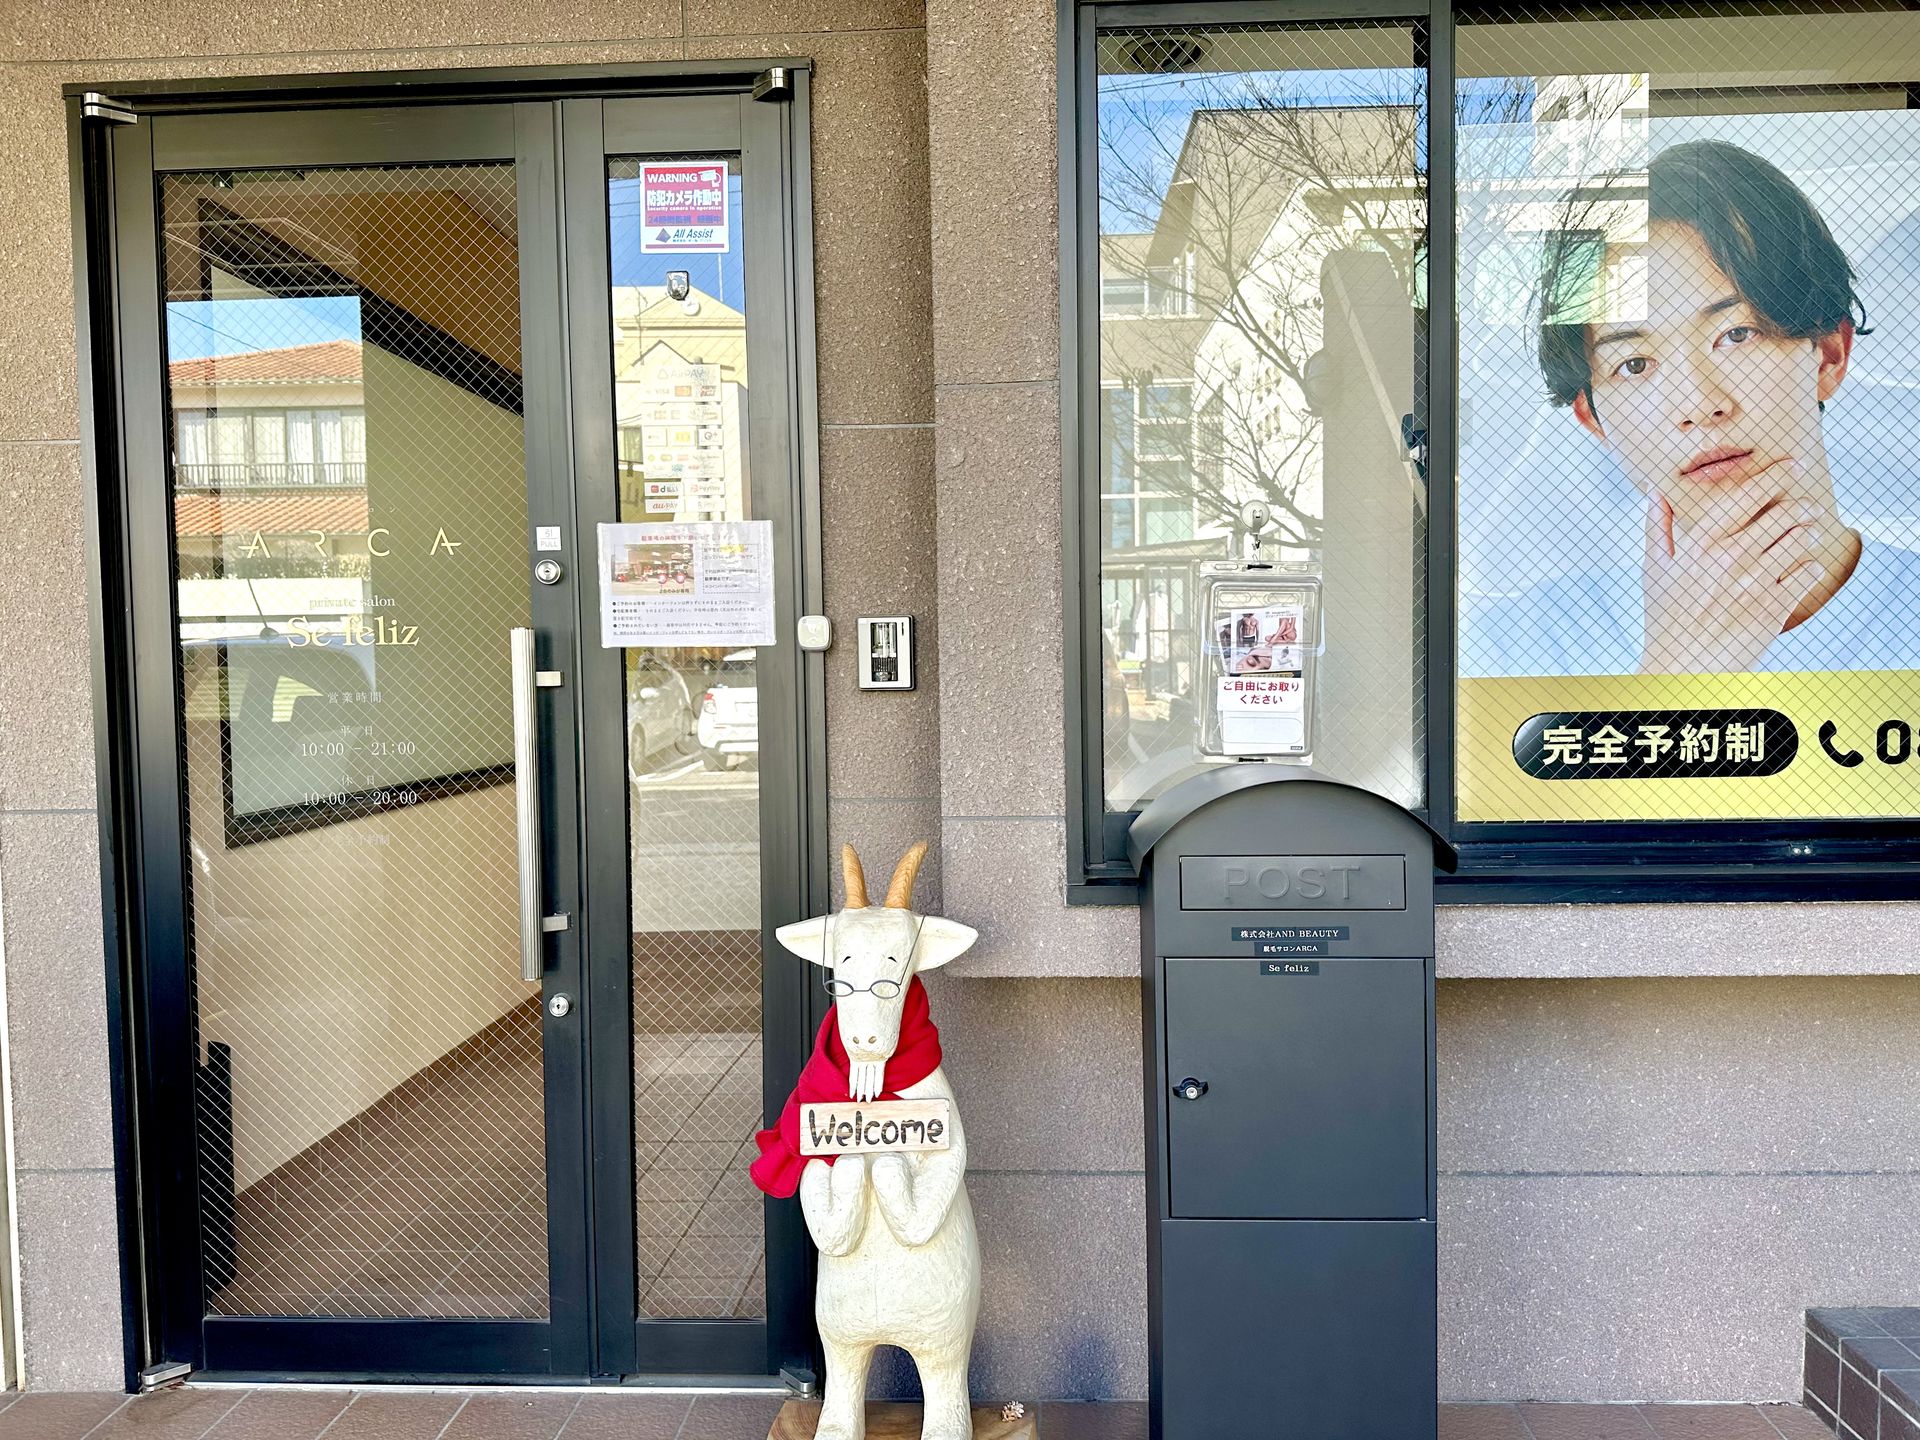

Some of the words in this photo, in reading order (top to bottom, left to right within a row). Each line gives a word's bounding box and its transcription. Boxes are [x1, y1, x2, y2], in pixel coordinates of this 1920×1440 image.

[647, 173, 698, 183] WARNING
[646, 189, 722, 206] 防犯カメラ作動中
[673, 229, 686, 239] All
[686, 228, 714, 239] Assist
[238, 527, 462, 559] ARCA
[309, 596, 357, 610] private
[359, 594, 396, 608] salon
[286, 616, 332, 648] Se
[342, 614, 420, 647] feliz
[1223, 680, 1300, 692] ご自由にお取り
[1240, 694, 1284, 705] ください
[302, 743, 344, 757] 10:00
[371, 741, 416, 756] 21:00
[1542, 722, 1766, 765] 完全予約制
[1876, 719, 1920, 765] 0
[303, 791, 346, 806] 10:00
[373, 790, 417, 805] 20:00
[1222, 865, 1361, 900] POST
[1240, 929, 1295, 939] 株式会社AND
[1299, 929, 1339, 938] BEAUTY
[1269, 964, 1281, 973] Se
[1284, 964, 1310, 973] feliz
[808, 1109, 944, 1148] Welcome
